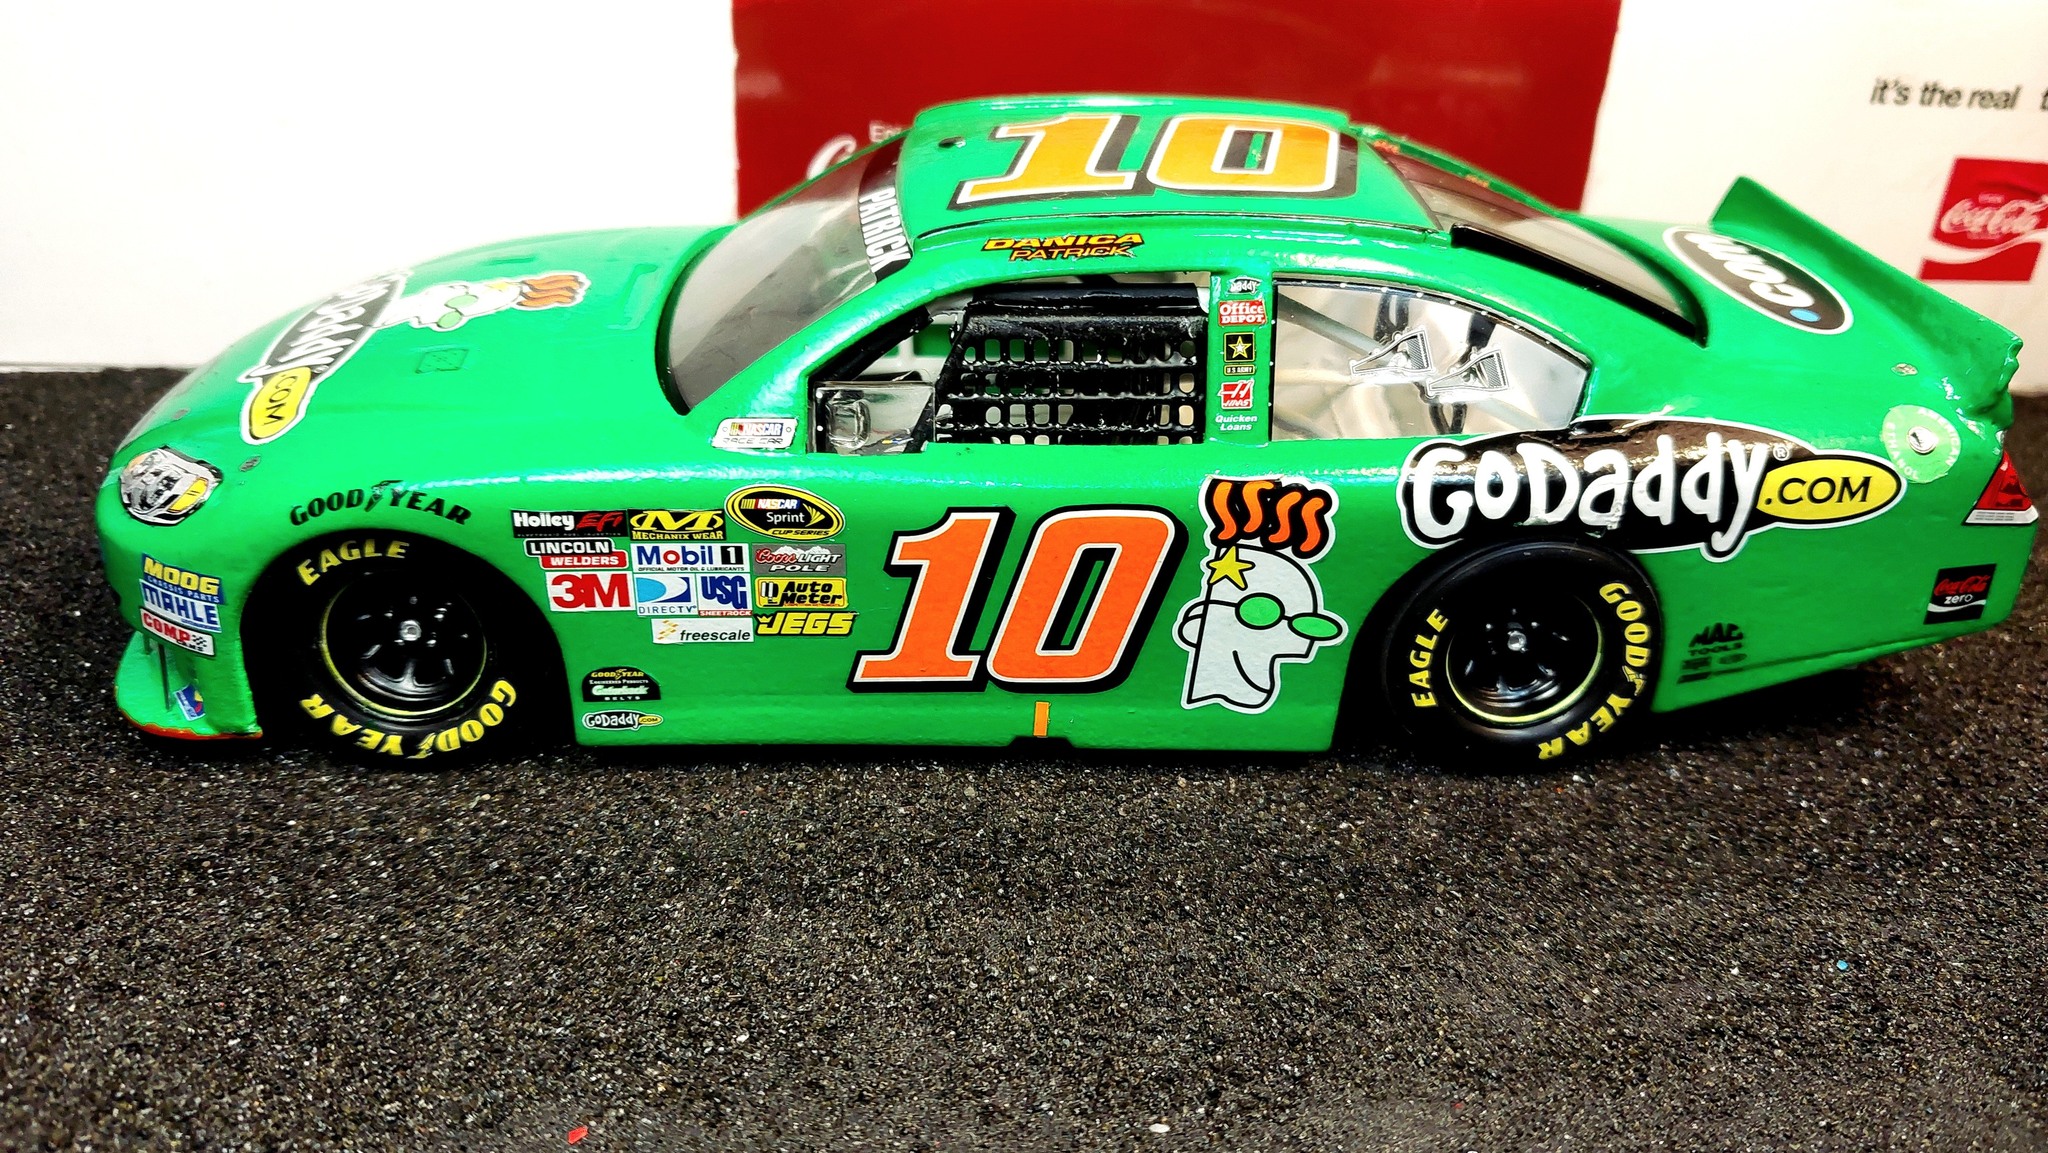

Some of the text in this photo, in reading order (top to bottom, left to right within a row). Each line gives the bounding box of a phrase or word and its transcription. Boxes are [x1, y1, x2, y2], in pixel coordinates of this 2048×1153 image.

[1870, 77, 1910, 106] it's
[1919, 80, 1962, 107] the
[1967, 84, 2023, 109] real
[954, 113, 1348, 207] 10
[858, 187, 912, 273] PATRICK
[983, 234, 1144, 250] DANICA
[1009, 246, 1132, 262] PATRICK
[1219, 304, 1264, 316] Office
[1215, 414, 1257, 423] Quicken
[1220, 423, 1252, 431] Loans
[1885, 421, 1919, 480] ETHANOL
[757, 498, 798, 509] NASCAR
[513, 512, 575, 531] Holley
[766, 512, 805, 524] Sprint
[632, 530, 724, 540] MECHANIX WEAR
[794, 528, 830, 536] SERIES
[530, 541, 610, 555] LINCOLN
[636, 545, 714, 565] Mobil
[755, 548, 841, 564] Coors LIGHT
[296, 538, 410, 586] EAGLE
[549, 556, 619, 566] WELDERS
[770, 564, 830, 572] POLE
[143, 556, 220, 595] MOOG
[551, 573, 631, 609] 3M
[700, 575, 748, 609] USG
[784, 581, 833, 593] Auto
[1933, 575, 1991, 596] Coca-Cola
[141, 582, 219, 625] MAHLE
[187, 590, 220, 603] PARTS
[781, 592, 843, 605] Meter
[850, 507, 1186, 691] 10
[1943, 593, 1974, 605] zero
[143, 612, 191, 643] COMP
[757, 612, 855, 635] JEGS
[680, 630, 751, 641] freescale
[1408, 608, 1450, 708] EAGLE
